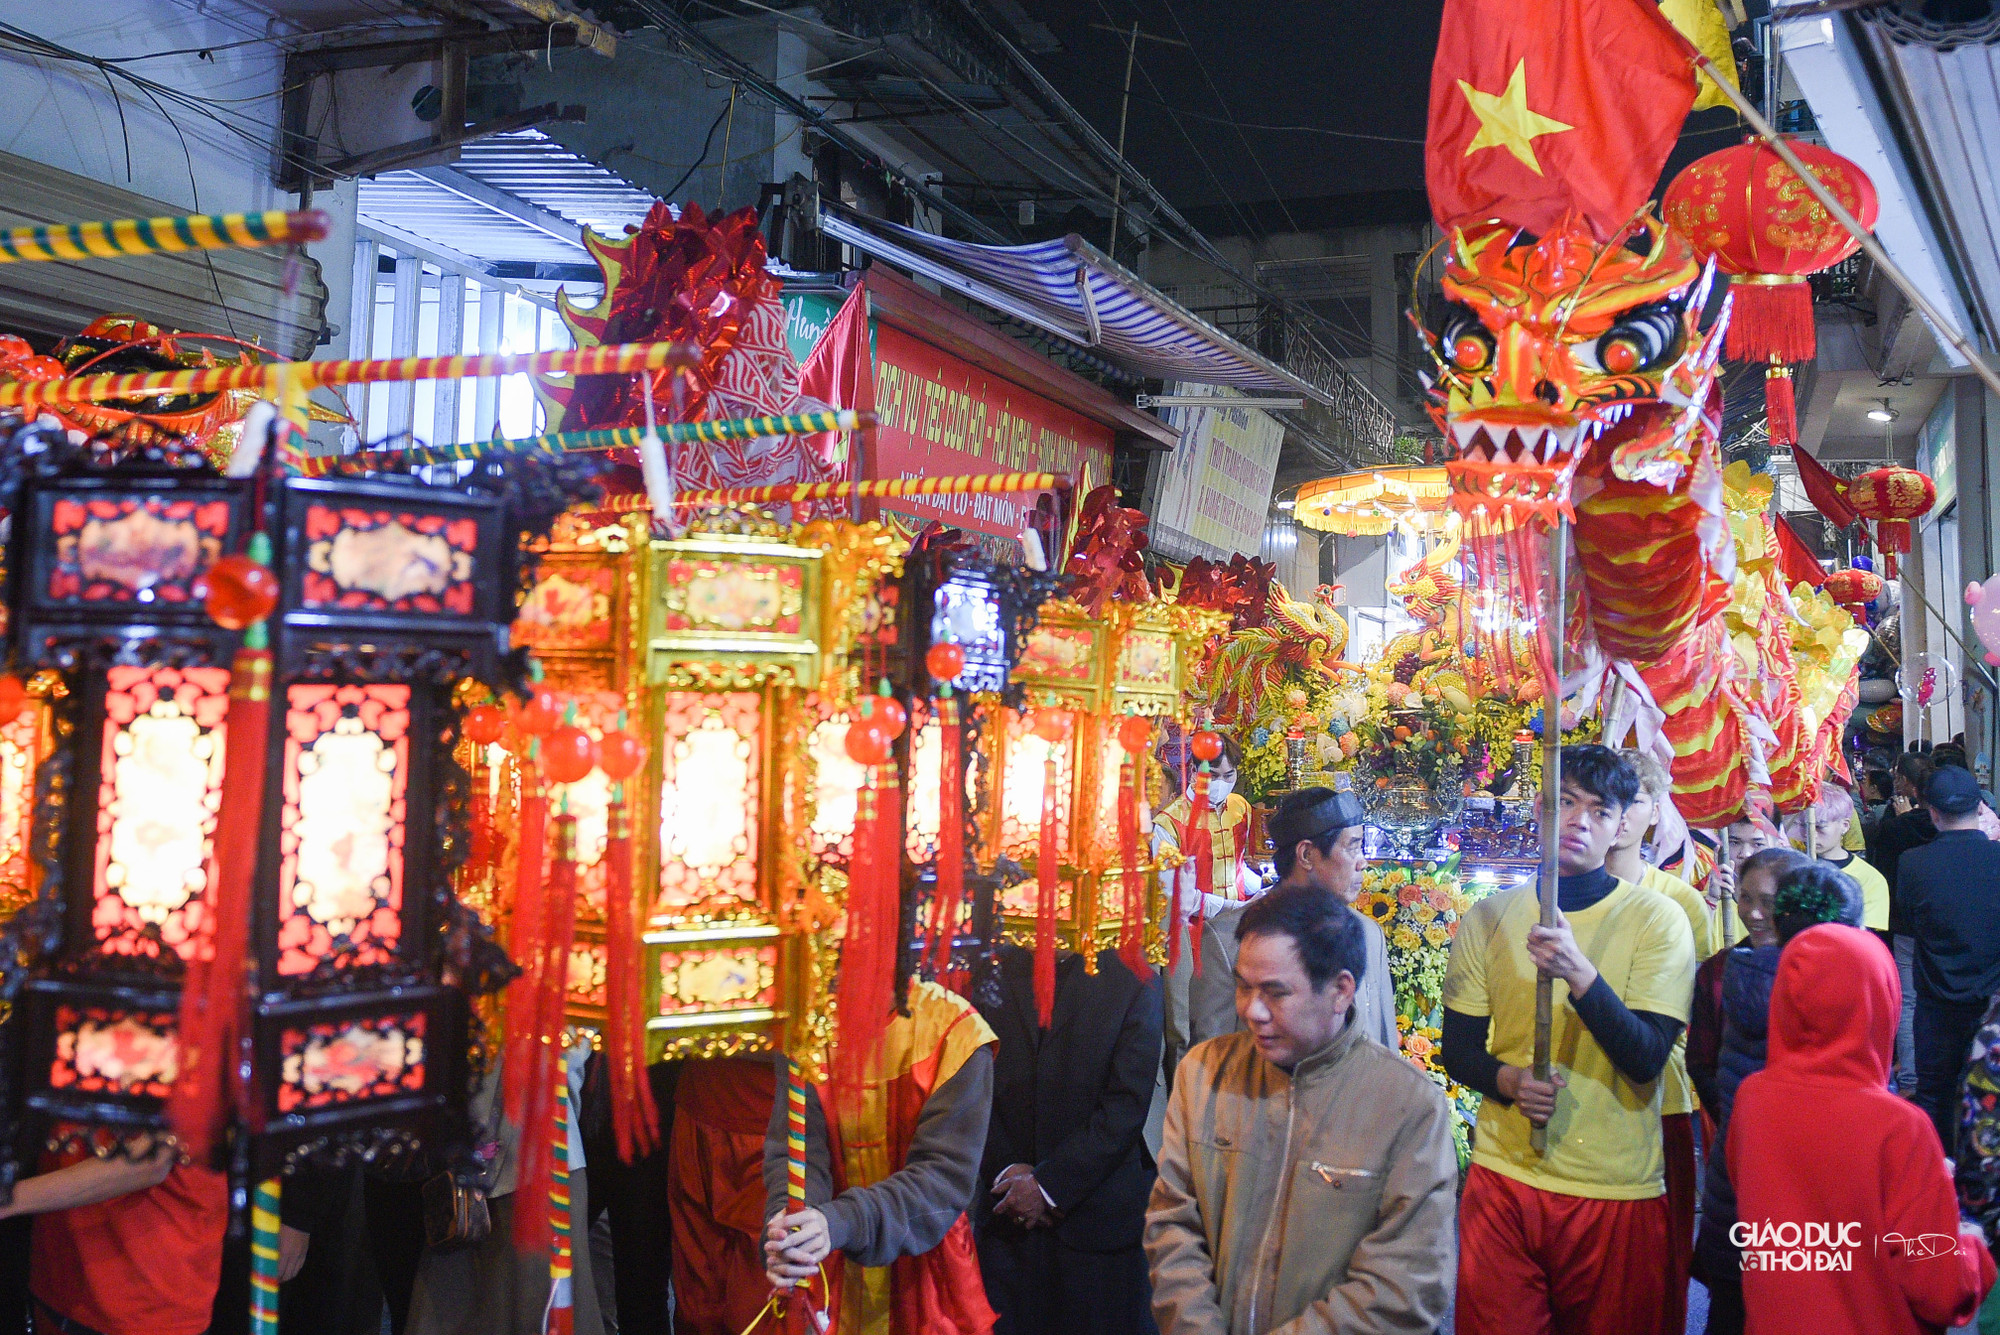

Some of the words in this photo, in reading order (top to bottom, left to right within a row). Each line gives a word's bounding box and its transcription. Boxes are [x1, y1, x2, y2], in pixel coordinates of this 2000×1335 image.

[874, 360, 906, 439] DỊCH
[903, 372, 924, 450] VỤ
[921, 366, 947, 456] TIỆC
[943, 376, 971, 453] CƯỚI
[966, 382, 988, 458] HỎI
[991, 397, 1011, 474] HỘI
[992, 492, 1015, 528] MÓN
